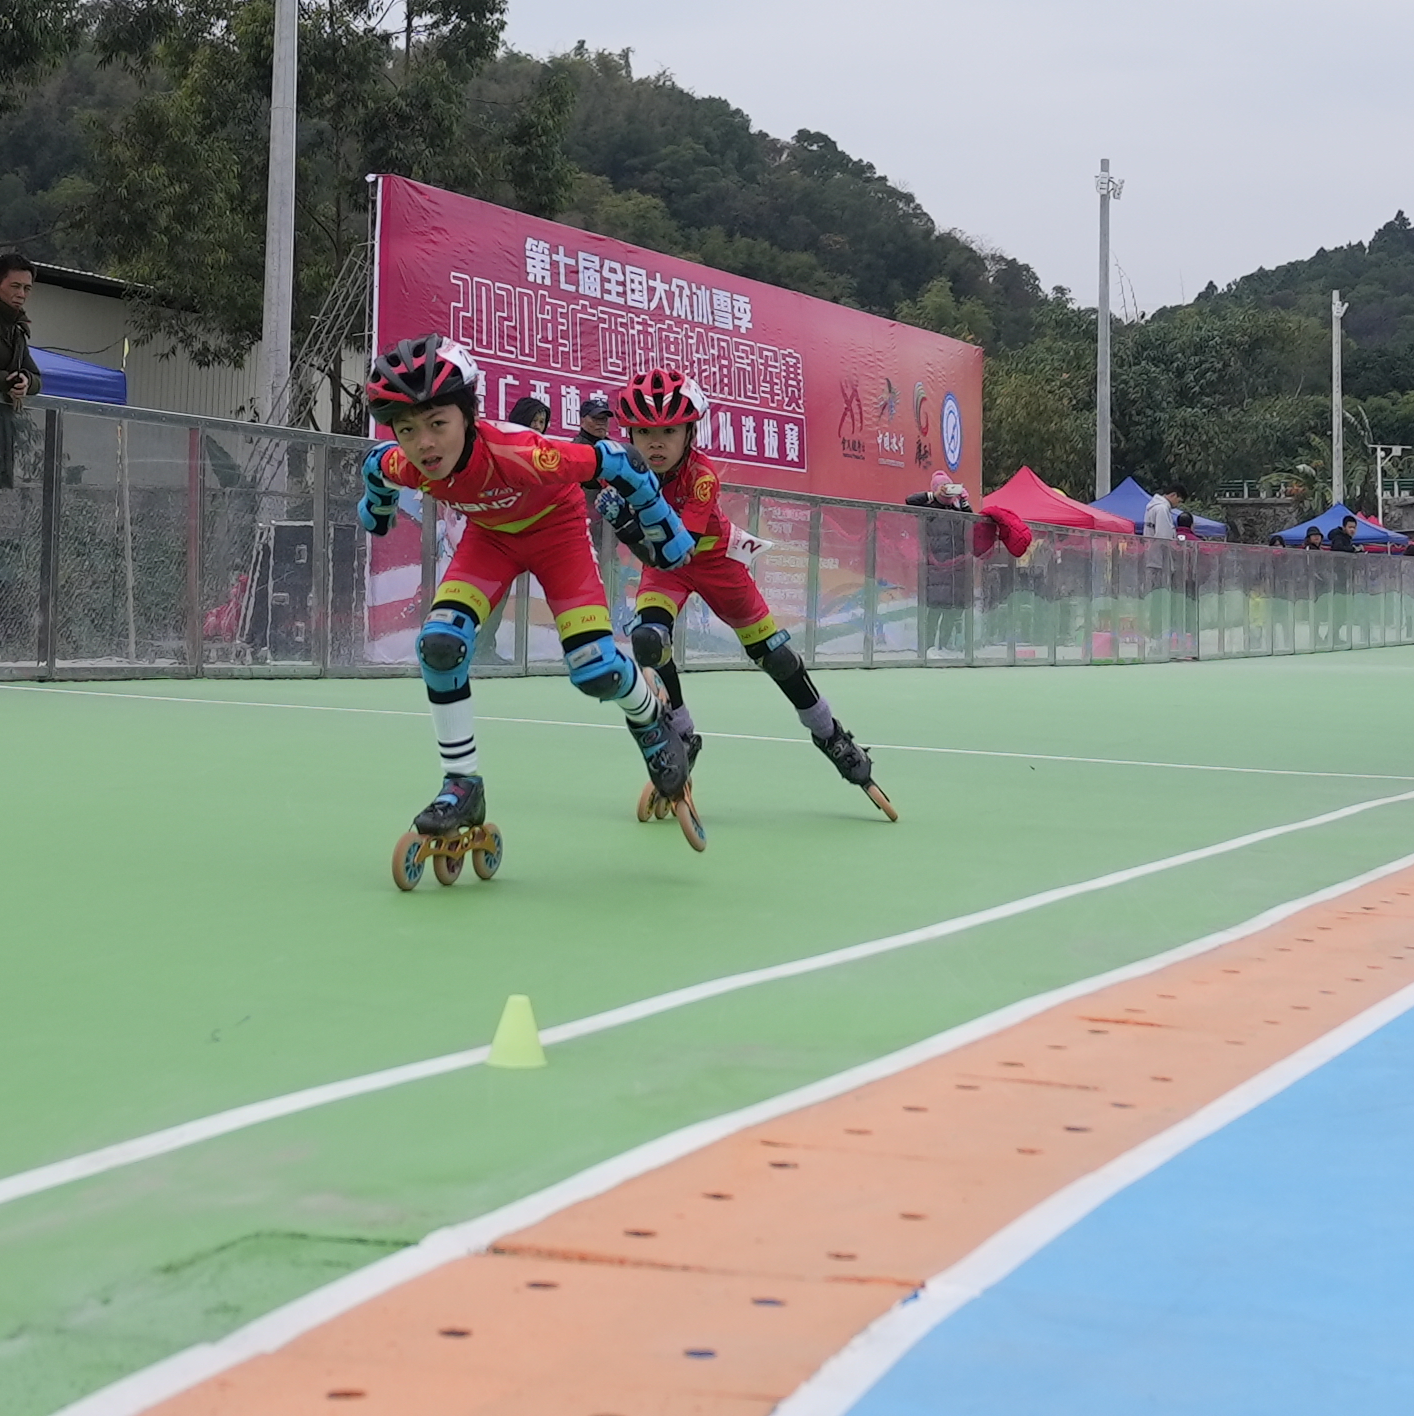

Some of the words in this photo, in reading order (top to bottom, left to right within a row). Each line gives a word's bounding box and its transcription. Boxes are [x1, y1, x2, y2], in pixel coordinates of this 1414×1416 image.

[524, 236, 753, 334] 第七届全国大众冰雪季
